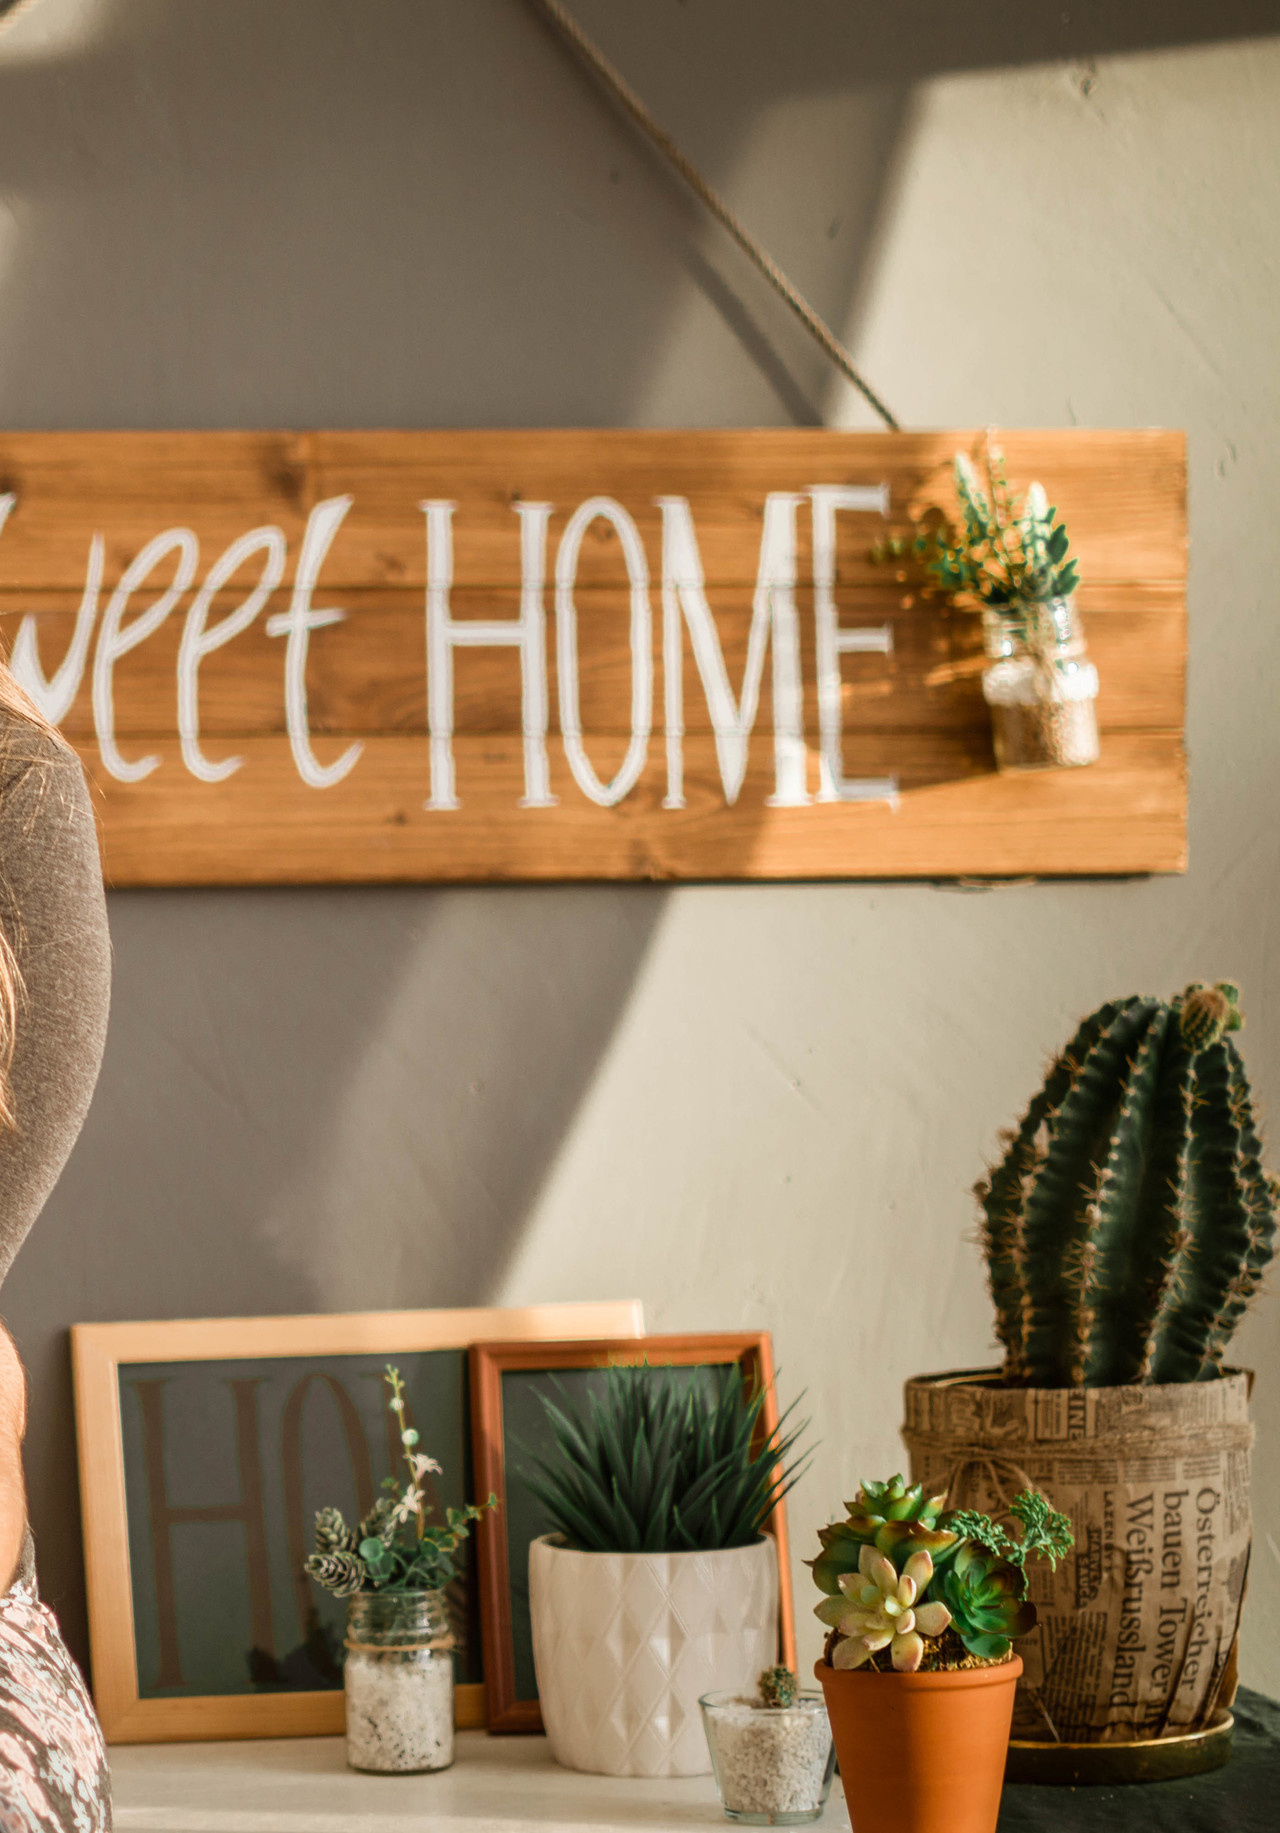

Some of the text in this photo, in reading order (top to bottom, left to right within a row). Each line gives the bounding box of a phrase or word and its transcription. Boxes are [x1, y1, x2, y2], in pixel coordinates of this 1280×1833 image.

[420, 484, 901, 812] HOME
[1109, 1492, 1154, 1709] Weißrussland
[1160, 1489, 1189, 1589] bauen
[1180, 1487, 1220, 1691] Österreicher
[1150, 1598, 1188, 1693] Tower
